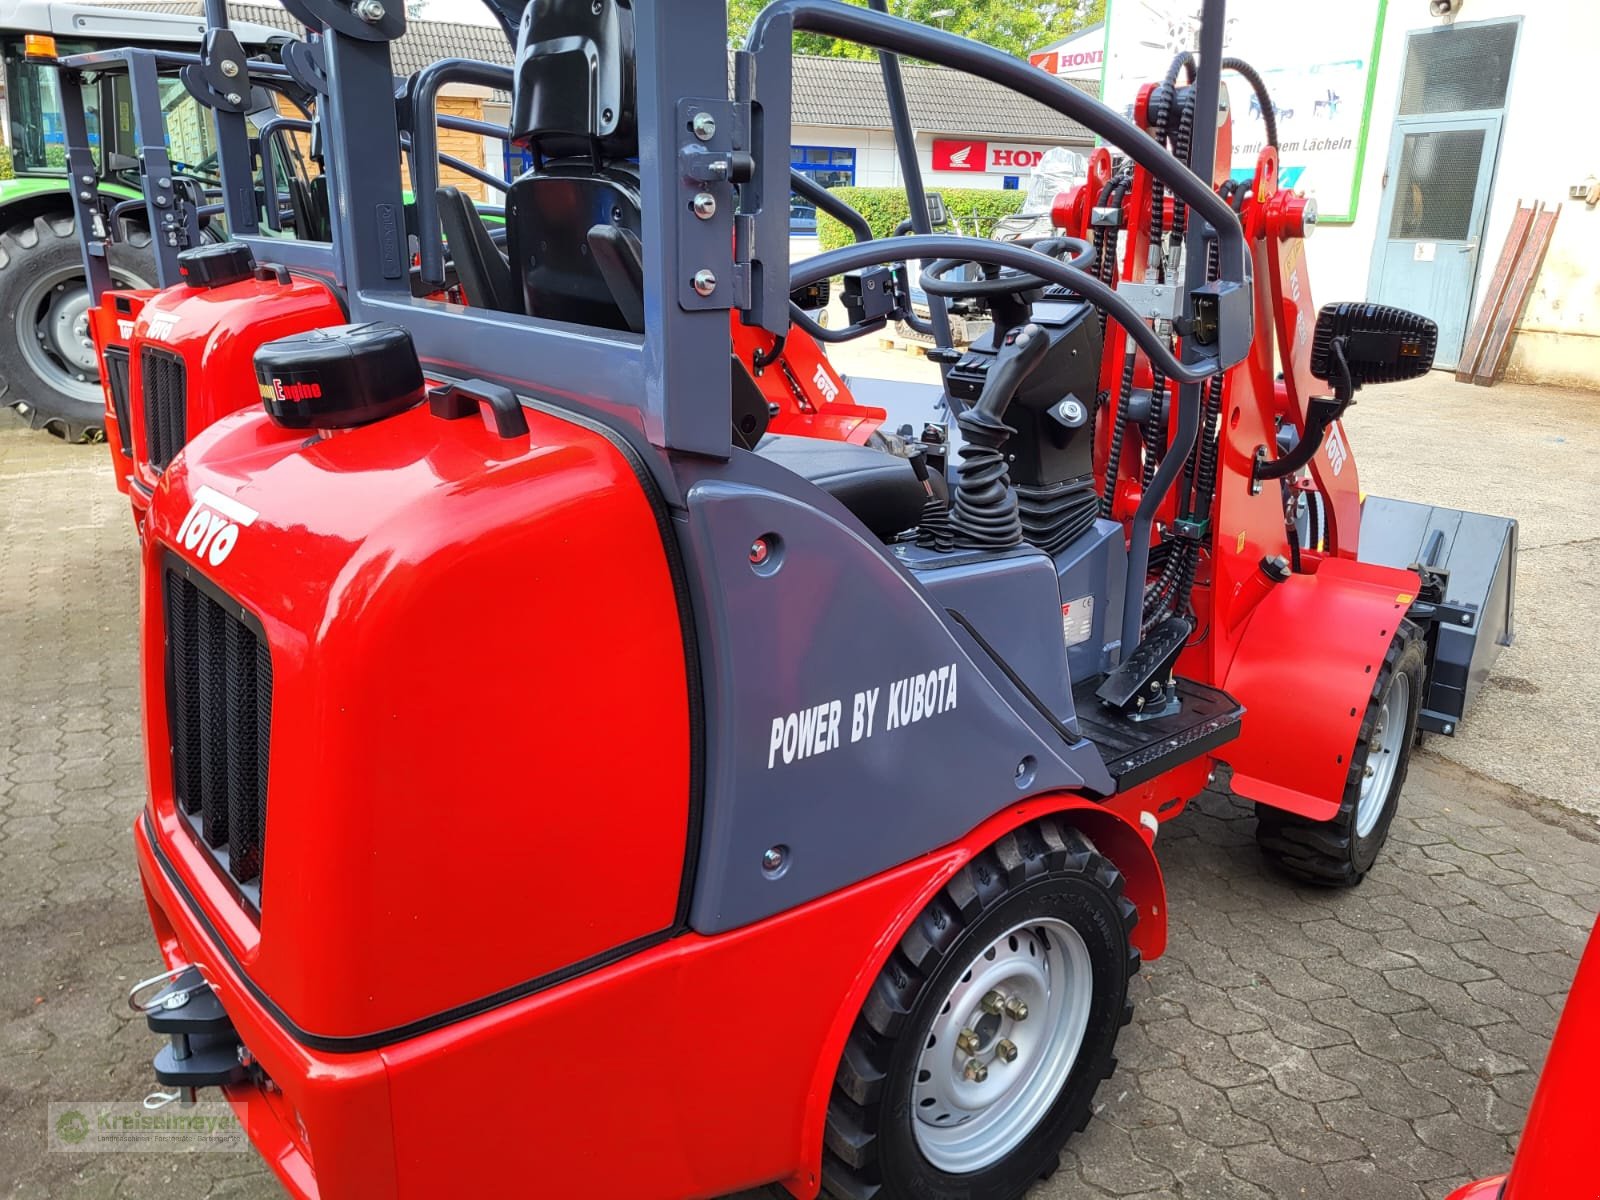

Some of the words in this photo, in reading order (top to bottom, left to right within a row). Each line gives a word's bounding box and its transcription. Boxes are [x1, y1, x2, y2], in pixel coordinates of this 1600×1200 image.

[992, 149, 1045, 167] HON
[1302, 136, 1353, 152] Lächeln
[175, 485, 260, 567] TOYO
[768, 699, 843, 770] POWER
[851, 686, 880, 744] BY
[886, 663, 958, 731] KUBOTA
